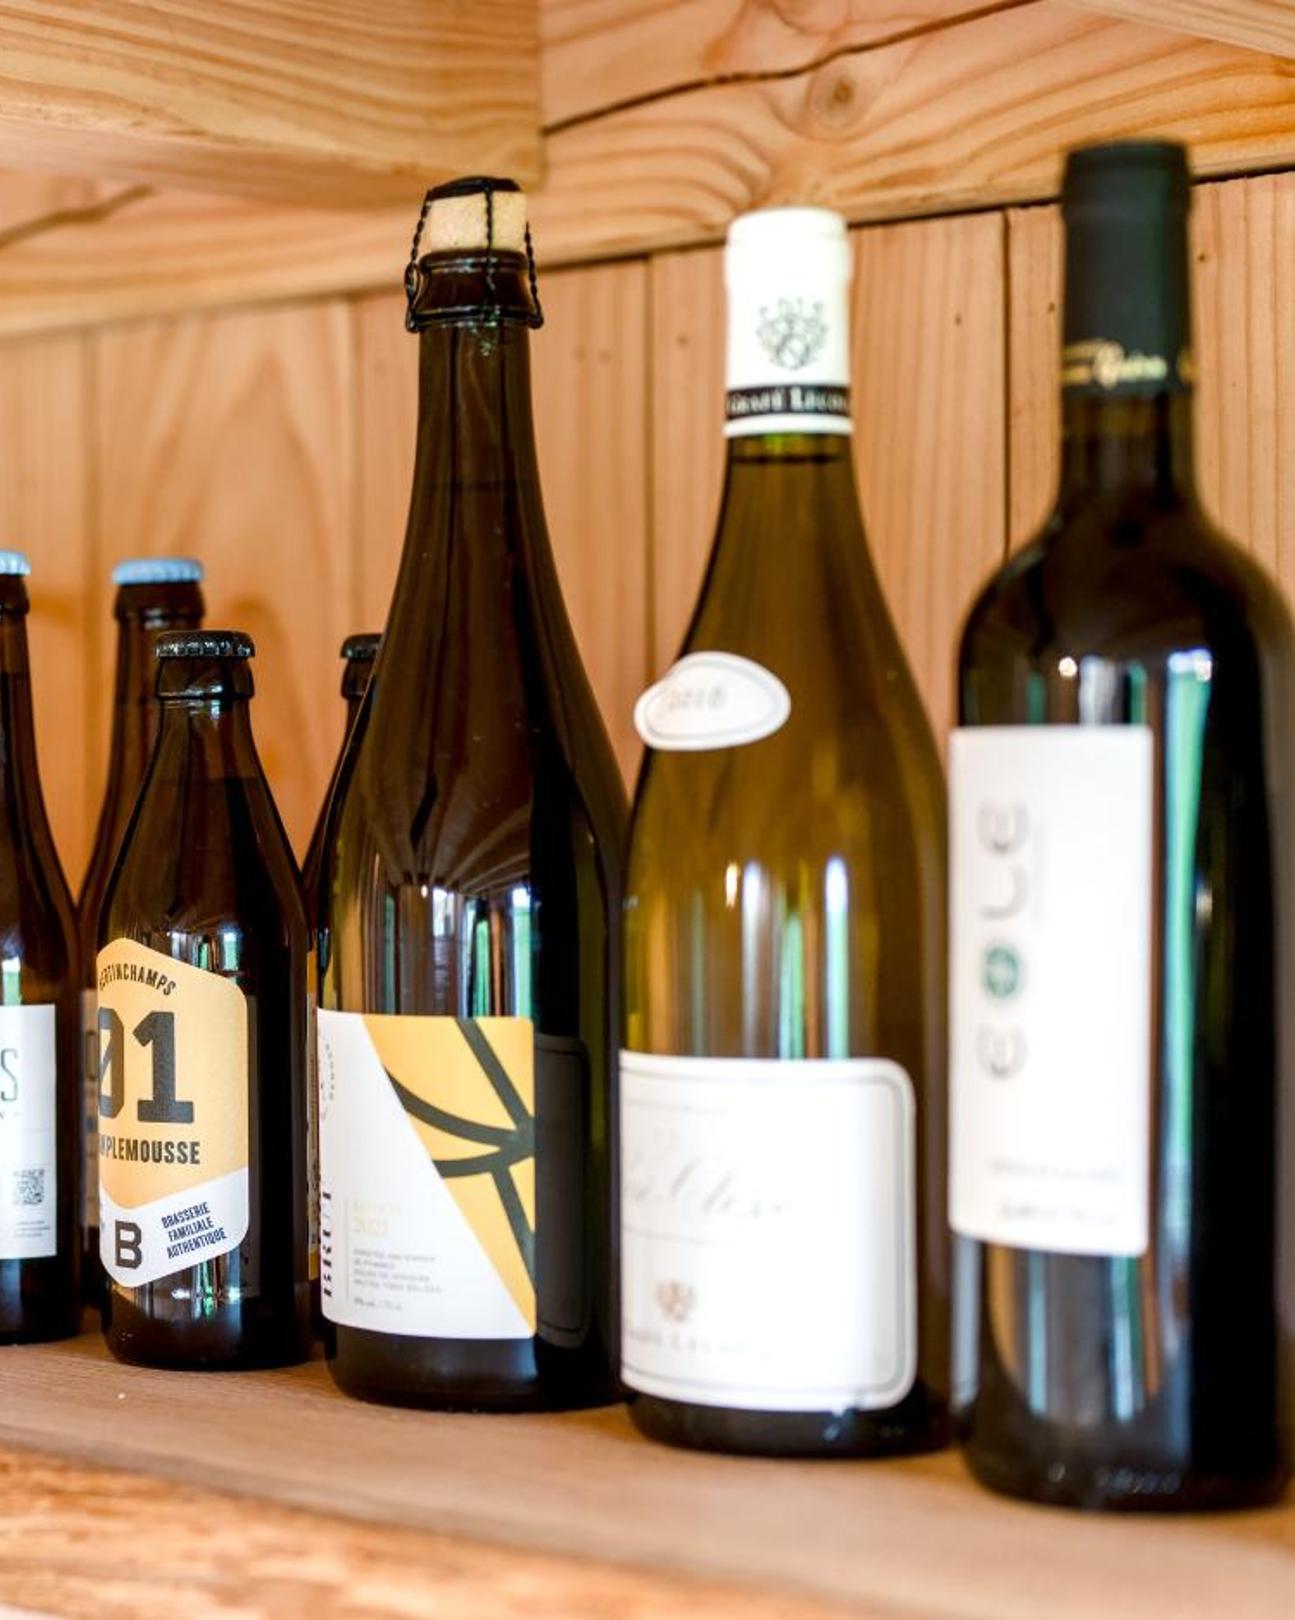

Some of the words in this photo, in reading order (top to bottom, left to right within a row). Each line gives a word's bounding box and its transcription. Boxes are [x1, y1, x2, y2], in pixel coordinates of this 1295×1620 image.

[98, 1007, 194, 1124] 01
[161, 1201, 211, 1229] BRASSERIE
[168, 1216, 214, 1242] FAMILIALE
[114, 1220, 143, 1270] B
[166, 1227, 228, 1259] AUTHENTIQUE
